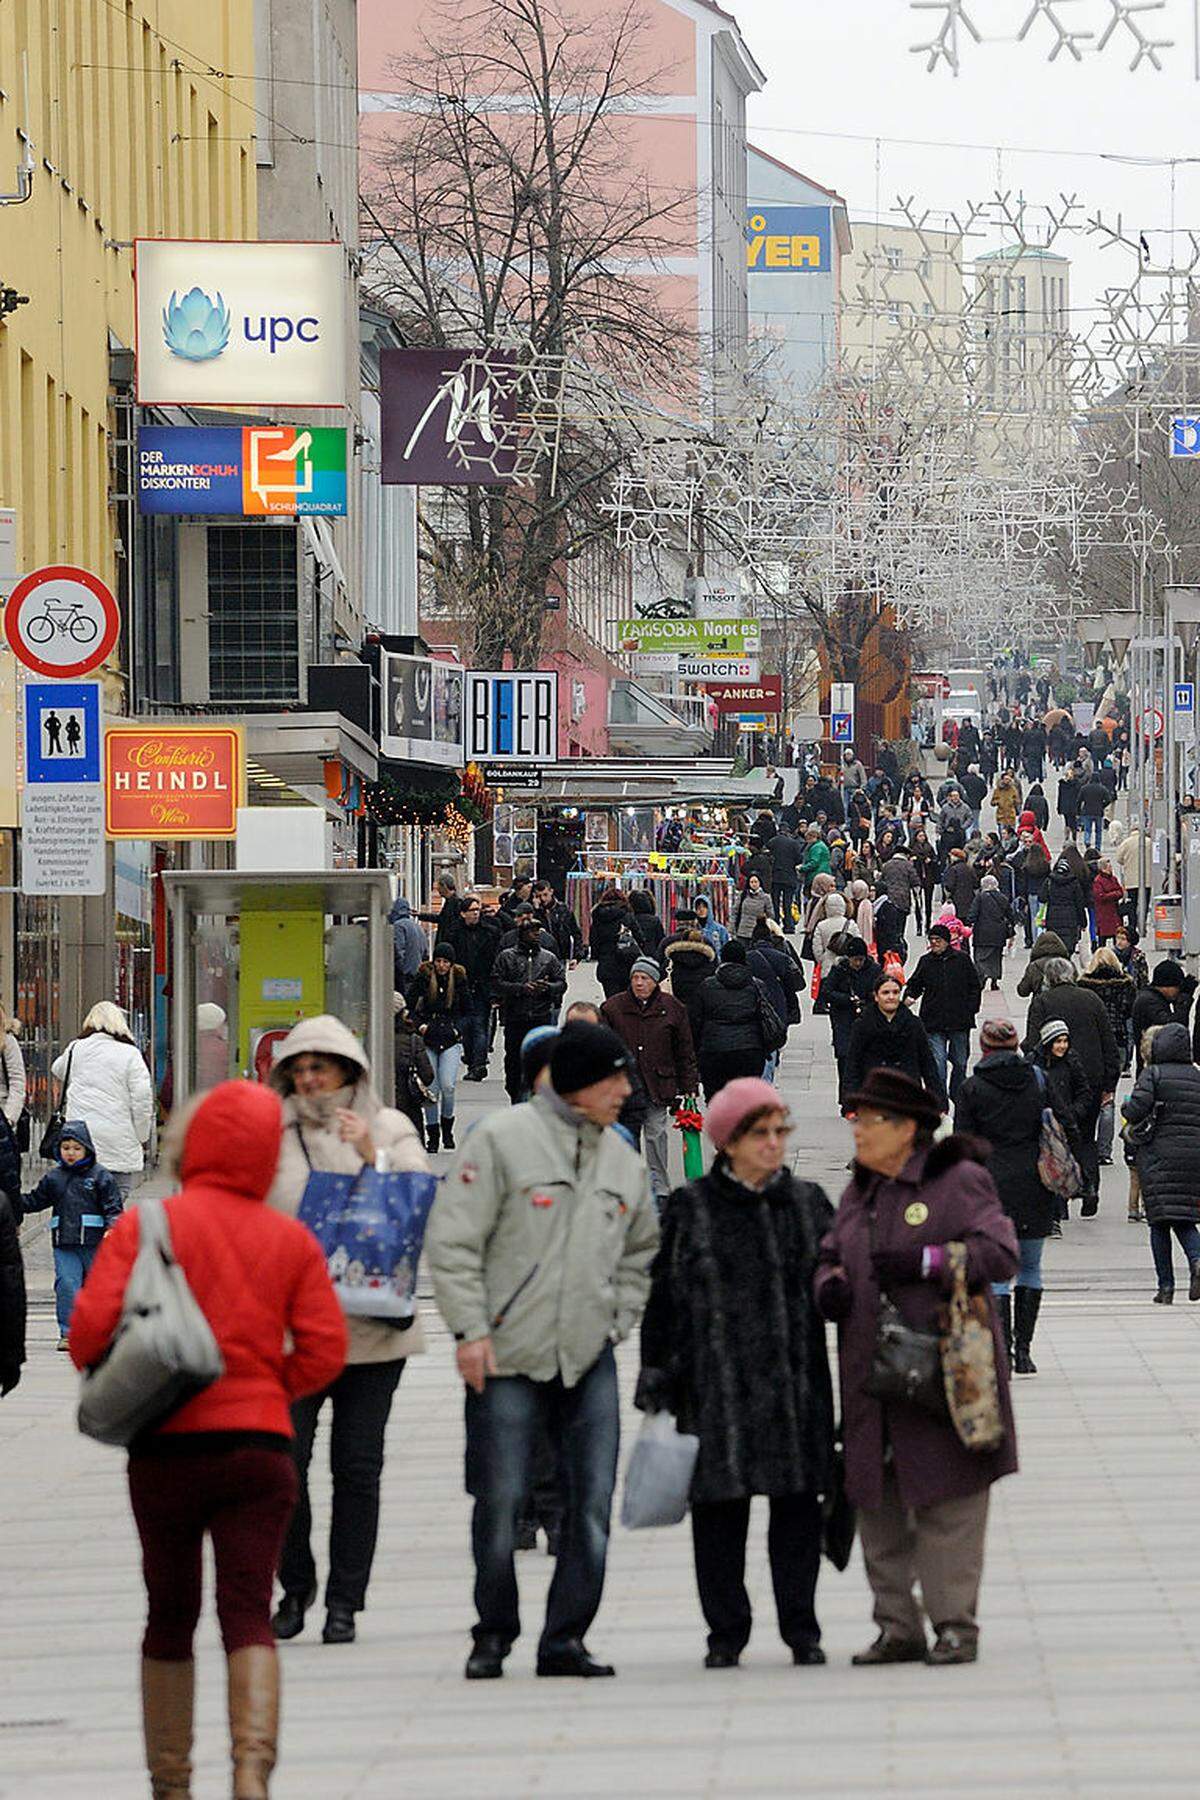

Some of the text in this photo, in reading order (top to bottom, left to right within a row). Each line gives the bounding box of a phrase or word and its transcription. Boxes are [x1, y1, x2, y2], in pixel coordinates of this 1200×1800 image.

[243, 315, 320, 353] upc
[141, 451, 164, 463] DER
[141, 464, 238, 476] MARKENSCHUH
[702, 594, 736, 602] TISSOT
[622, 622, 698, 638] YAKISOBA
[677, 663, 739, 676] swatch
[723, 689, 764, 699] ANKER
[472, 679, 552, 755] BEER
[115, 771, 227, 790] HEINDL
